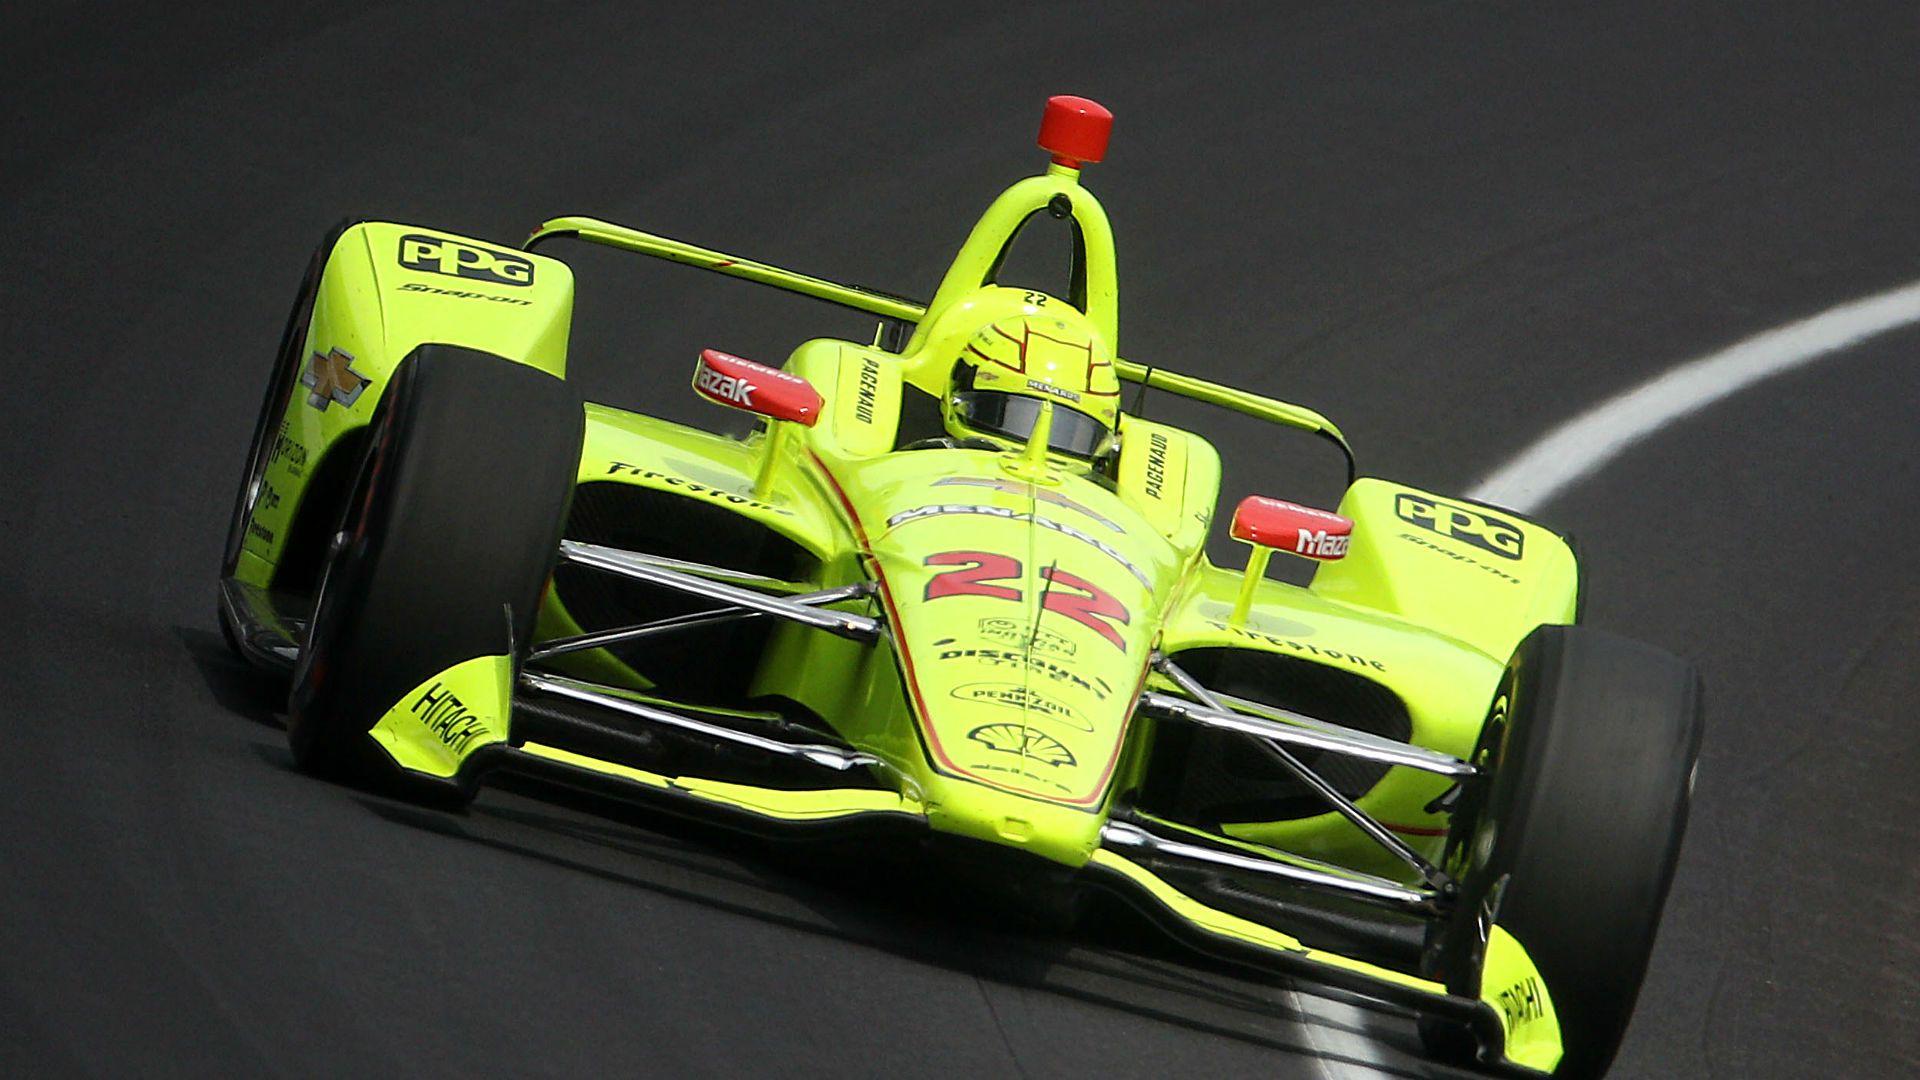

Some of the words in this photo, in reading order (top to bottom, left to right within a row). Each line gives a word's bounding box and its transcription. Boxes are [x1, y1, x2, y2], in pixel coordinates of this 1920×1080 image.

[403, 239, 530, 282] PPG
[1024, 291, 1048, 307] 22
[699, 366, 758, 407] azak
[855, 357, 880, 425] PAGENAUD
[1145, 433, 1168, 500] PAGENAUD
[1399, 497, 1520, 555] PPG
[922, 549, 1130, 654] 22
[411, 682, 490, 755] HITACHI
[972, 689, 1072, 717] PENNZOIL
